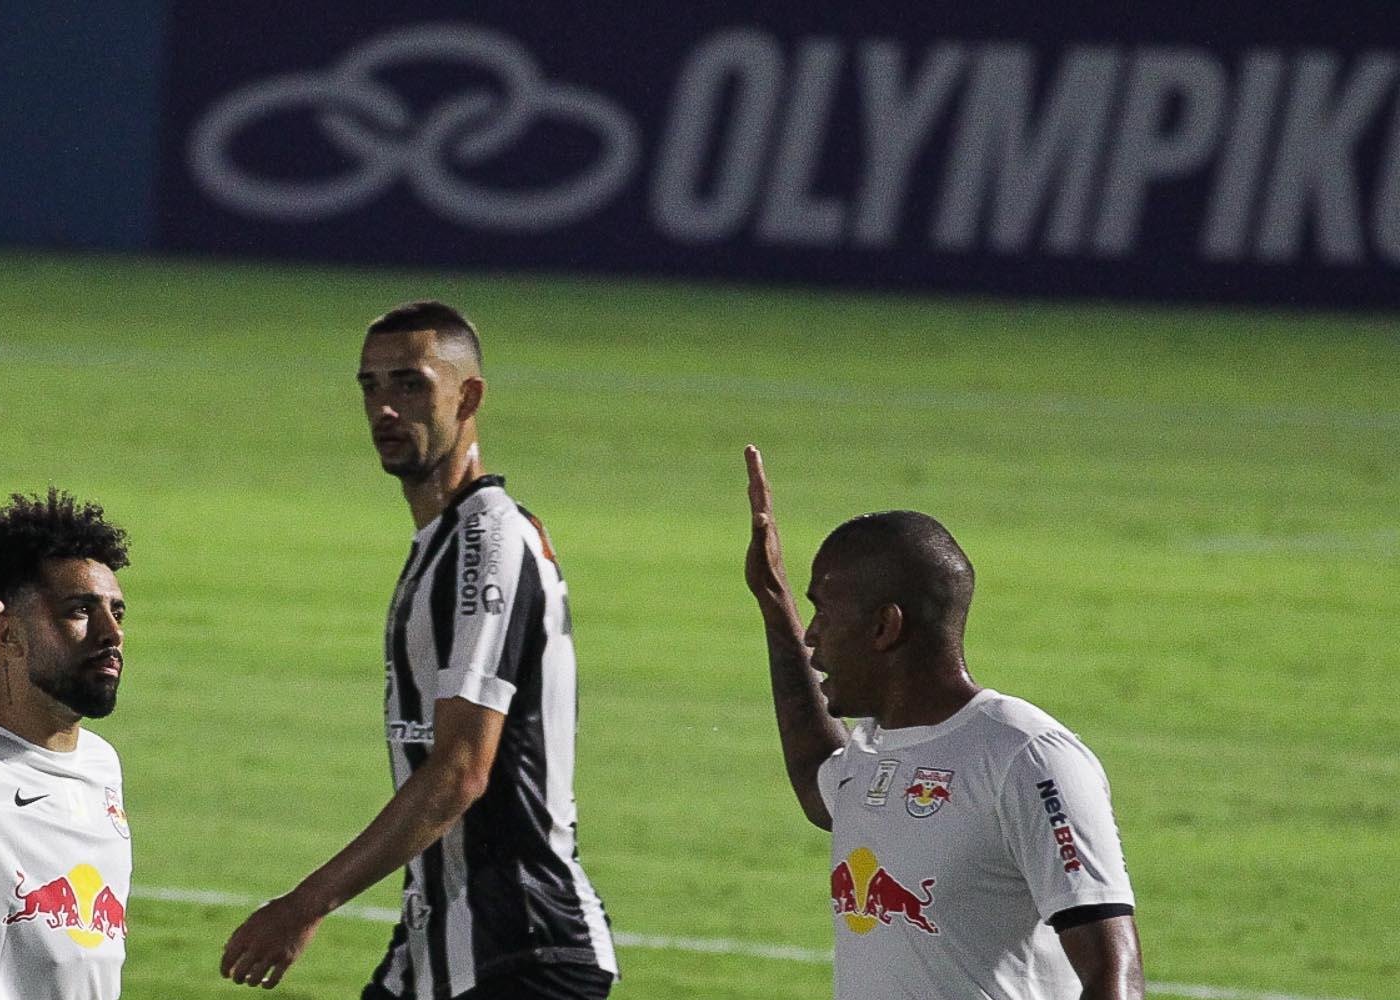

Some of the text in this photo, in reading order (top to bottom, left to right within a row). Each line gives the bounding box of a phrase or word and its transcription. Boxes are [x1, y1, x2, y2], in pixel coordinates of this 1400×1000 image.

[650, 27, 1400, 265] OLYMPIK
[461, 511, 488, 615] mbracon
[1037, 779, 1081, 873] NetBet
